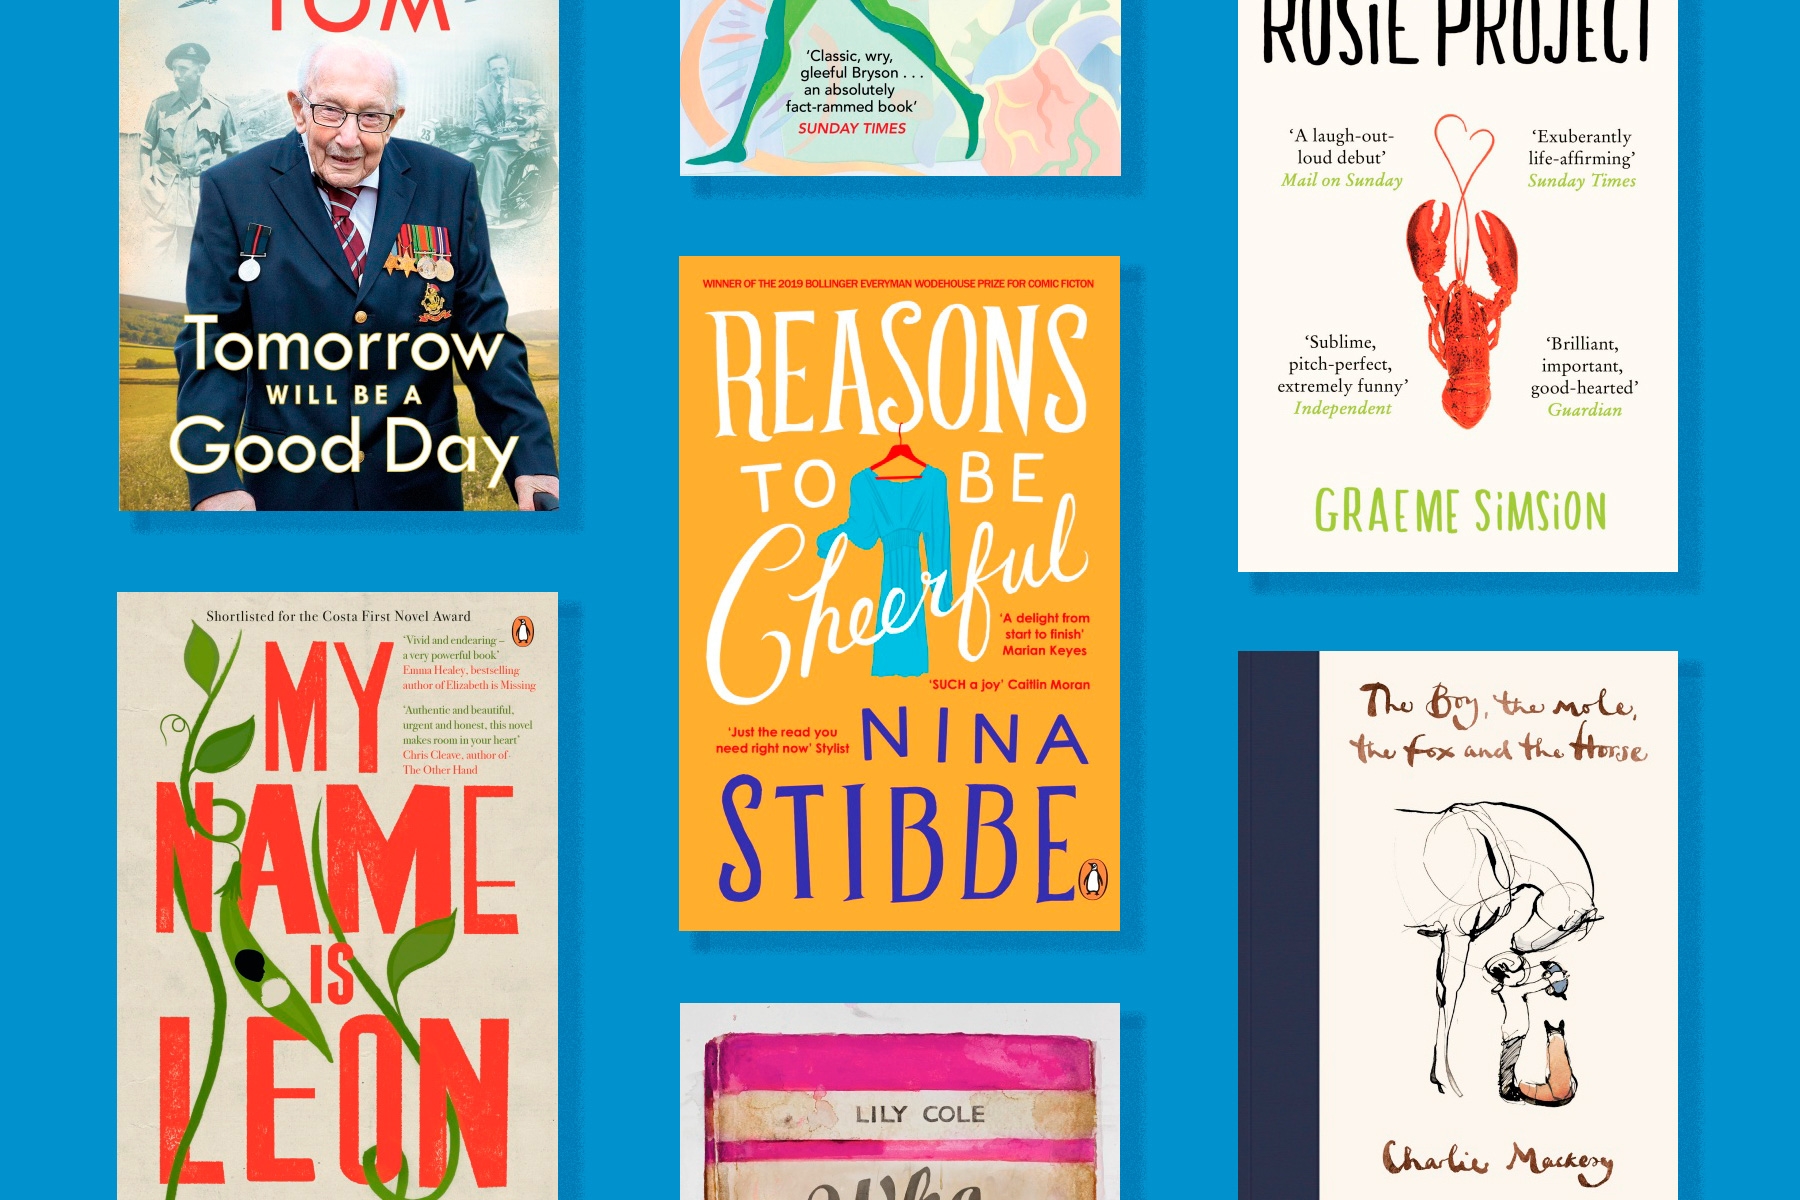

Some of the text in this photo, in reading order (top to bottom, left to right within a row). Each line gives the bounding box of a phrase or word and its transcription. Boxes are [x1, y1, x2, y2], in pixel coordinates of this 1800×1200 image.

[806, 48, 893, 65] ‘Classic, wry,
[800, 65, 848, 82] gleeful
[852, 66, 899, 82] Bryson
[804, 82, 895, 99] an absolutely
[785, 99, 917, 113] fact-rammed book’
[799, 122, 906, 135] SUNDAY TIMES
[1289, 127, 1395, 147] ‘A laugh-out-
[1532, 127, 1633, 148] ‘Exuberantly
[1297, 148, 1386, 165] loud debut’
[1528, 149, 1636, 170] life-affirming’
[1280, 171, 1403, 192] Mail on Sunday
[1527, 172, 1637, 192] Sunday Times
[702, 279, 1095, 289] WINNER OF THE 2019 BOLLINGER EVERYMAN WODEHOUSE PRIZE FOR COMIC FICTON
[184, 314, 504, 371] Tomorrow
[1304, 333, 1377, 352] ‘Sublime,
[1546, 335, 1619, 354] ‘Brilliant,
[705, 301, 1088, 442] REASONS
[1288, 355, 1393, 376] pitch-perfect,
[1541, 357, 1624, 377] important,
[266, 385, 422, 405] WILL BE A
[1277, 377, 1409, 398] extremely funny’
[1530, 379, 1639, 399] good-hearted’
[1293, 399, 1393, 420] Independent
[1547, 401, 1623, 417] Guardian
[169, 415, 518, 488] Good Day
[740, 451, 1044, 512] TO BE
[1315, 486, 1460, 535] GRAEME
[706, 493, 1089, 705] Cheerful
[206, 609, 471, 622] Shortlisted for the Costa First Novel Award
[999, 612, 1090, 626] ‘A delight from
[403, 634, 430, 645] ‘Vivid
[431, 634, 449, 645] and
[450, 634, 498, 648] endearing
[1005, 628, 1084, 640] start to finish’
[409, 652, 429, 663] very
[431, 649, 472, 663] powerful
[472, 649, 500, 660] book’
[1002, 644, 1087, 658] Marian Keyes
[403, 664, 521, 678] Emma Healey, bestselling
[402, 679, 537, 693] author of Elizabeth is Missing
[929, 678, 1091, 693] ‘SUCH a joy’ Caitlin Moran
[265, 640, 394, 773] MY
[1359, 682, 1413, 717] The
[1493, 690, 1545, 715] the
[402, 704, 515, 715] ‘Authentic and beautiful,
[402, 719, 533, 733] urgent and honest, this novel
[728, 726, 838, 740] ‘Just the read you
[862, 706, 1089, 764] NINA
[403, 734, 521, 748] makes room in your heart’
[716, 742, 850, 756] need right now’ Stylist
[1349, 733, 1396, 764] the
[1464, 740, 1513, 760] and
[1518, 732, 1564, 760] the
[1569, 720, 1648, 762] Horse
[402, 749, 509, 761] Chris Cleave, author of
[402, 764, 478, 775] The Other Hand
[719, 774, 1077, 903] STIBBE
[156, 782, 519, 934] NAME
[310, 943, 354, 1005] IS
[159, 1014, 510, 1188] LEON
[855, 1105, 985, 1123] LILY COLE
[1382, 1140, 1489, 1174] Charlie
